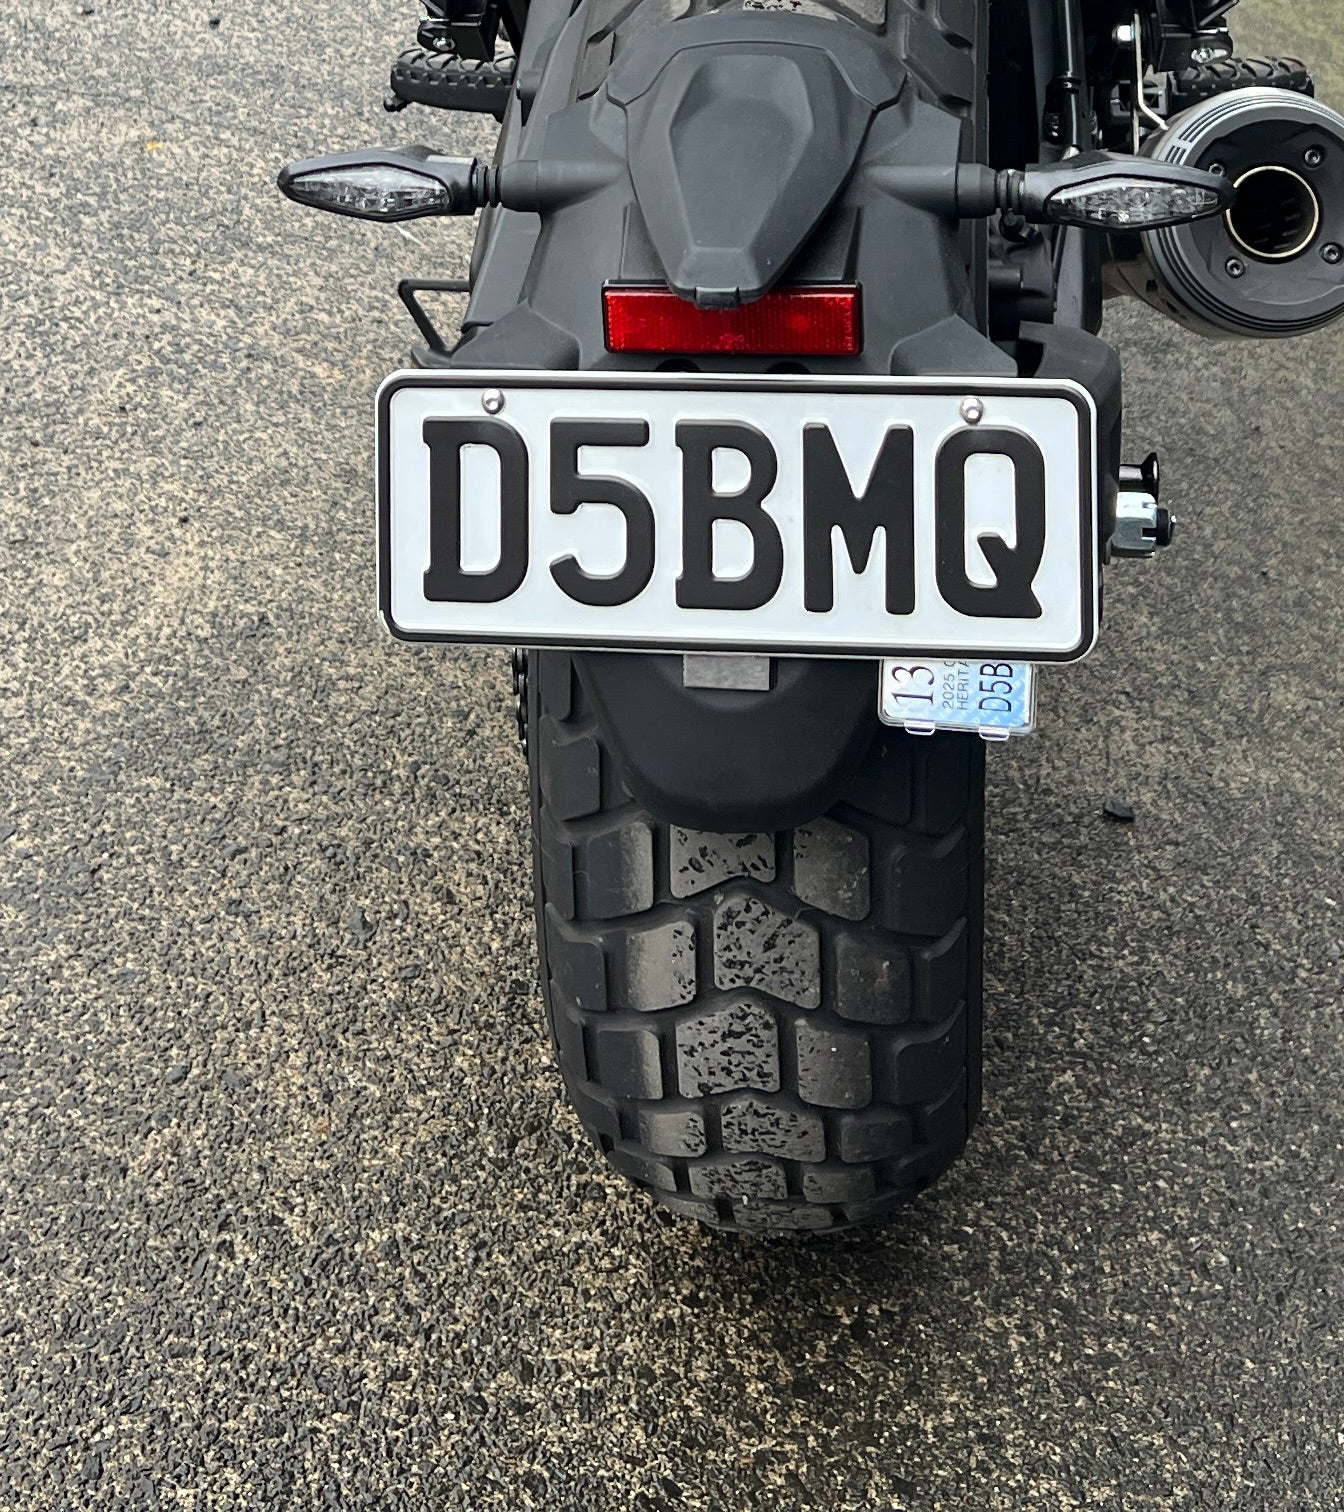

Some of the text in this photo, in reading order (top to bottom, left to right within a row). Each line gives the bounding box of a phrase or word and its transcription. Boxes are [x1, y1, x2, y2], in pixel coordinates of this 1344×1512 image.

[421, 416, 1047, 619] D5BMQ
[891, 665, 935, 707] 13
[942, 673, 956, 710] 2025
[978, 662, 1014, 713] D5B
